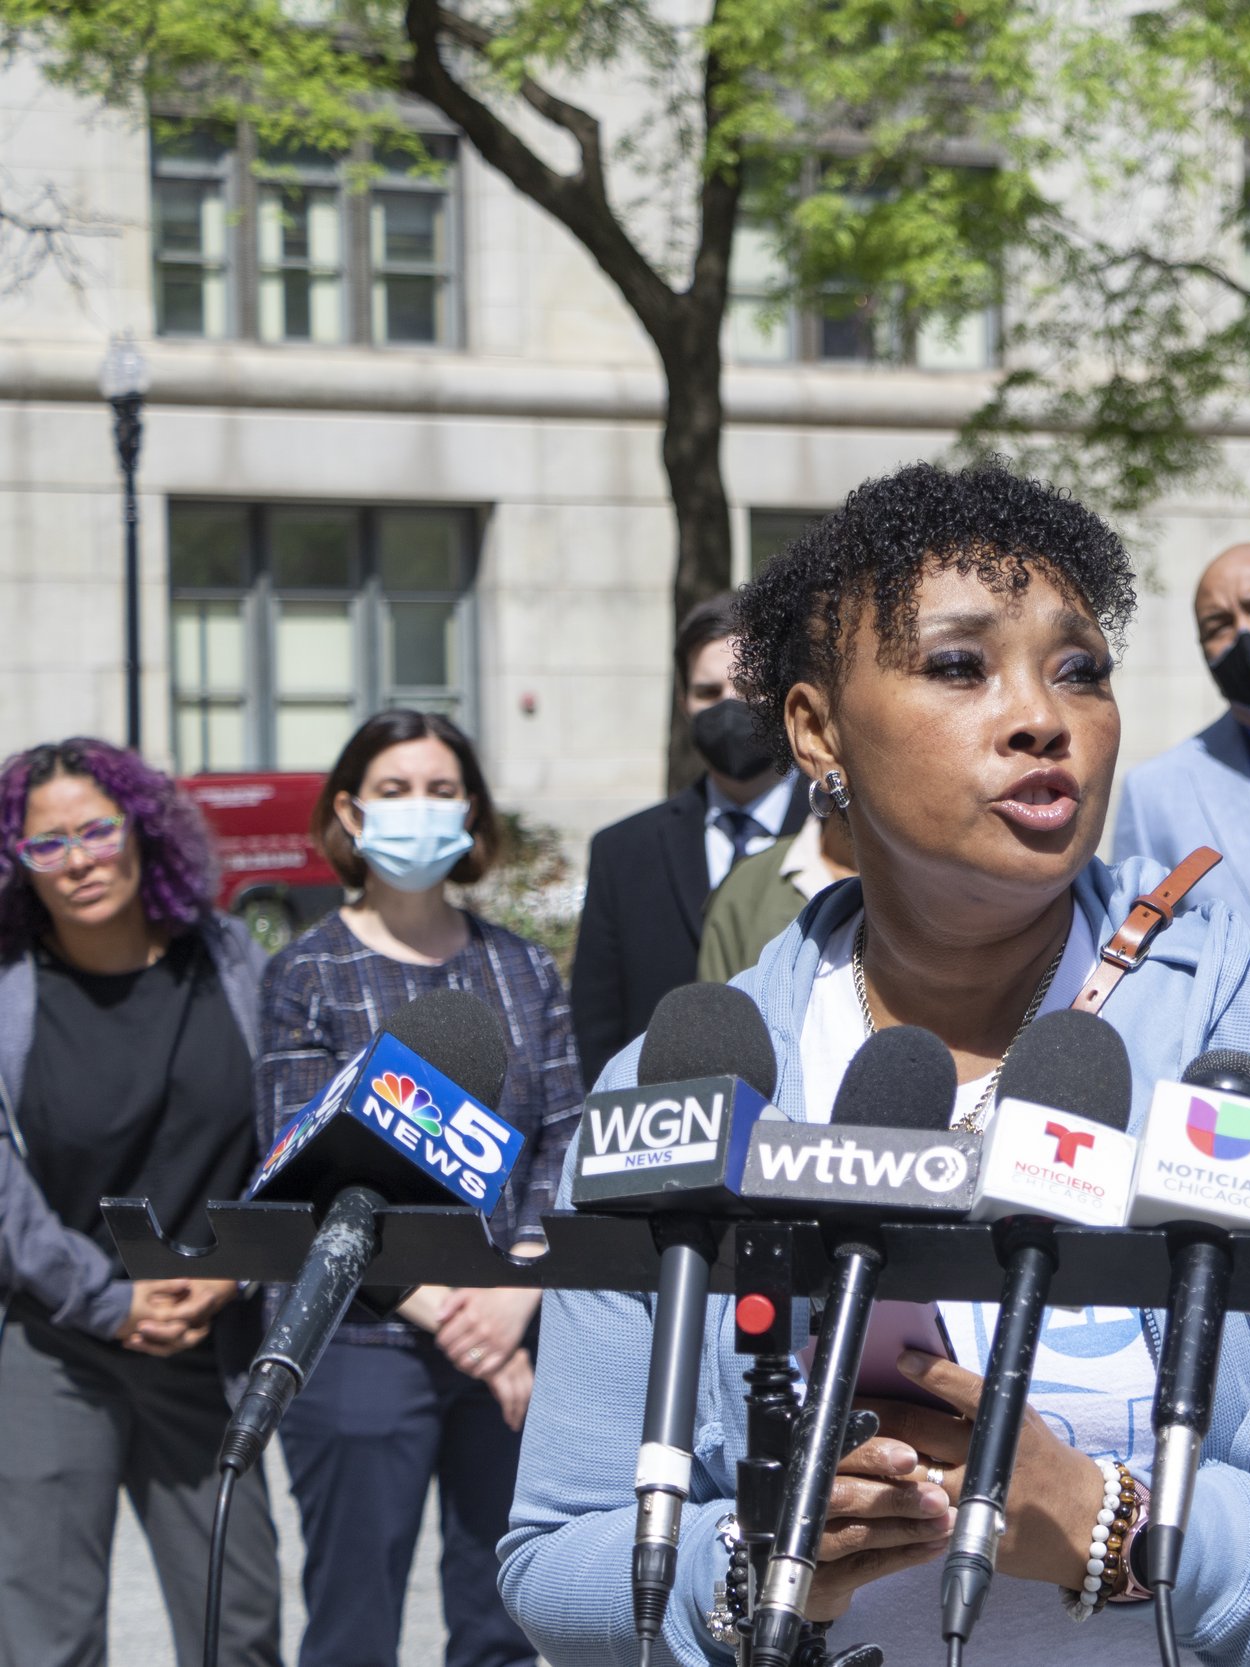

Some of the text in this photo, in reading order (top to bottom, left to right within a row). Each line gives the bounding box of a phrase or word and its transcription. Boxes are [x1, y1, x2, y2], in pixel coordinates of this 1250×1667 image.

[362, 1095, 488, 1200] NEWS
[444, 1100, 511, 1174] 5
[589, 1093, 724, 1155] WGN
[625, 1149, 673, 1169] NEWS
[758, 1138, 916, 1188] wttw
[1014, 1160, 1106, 1198] NOTICIERO
